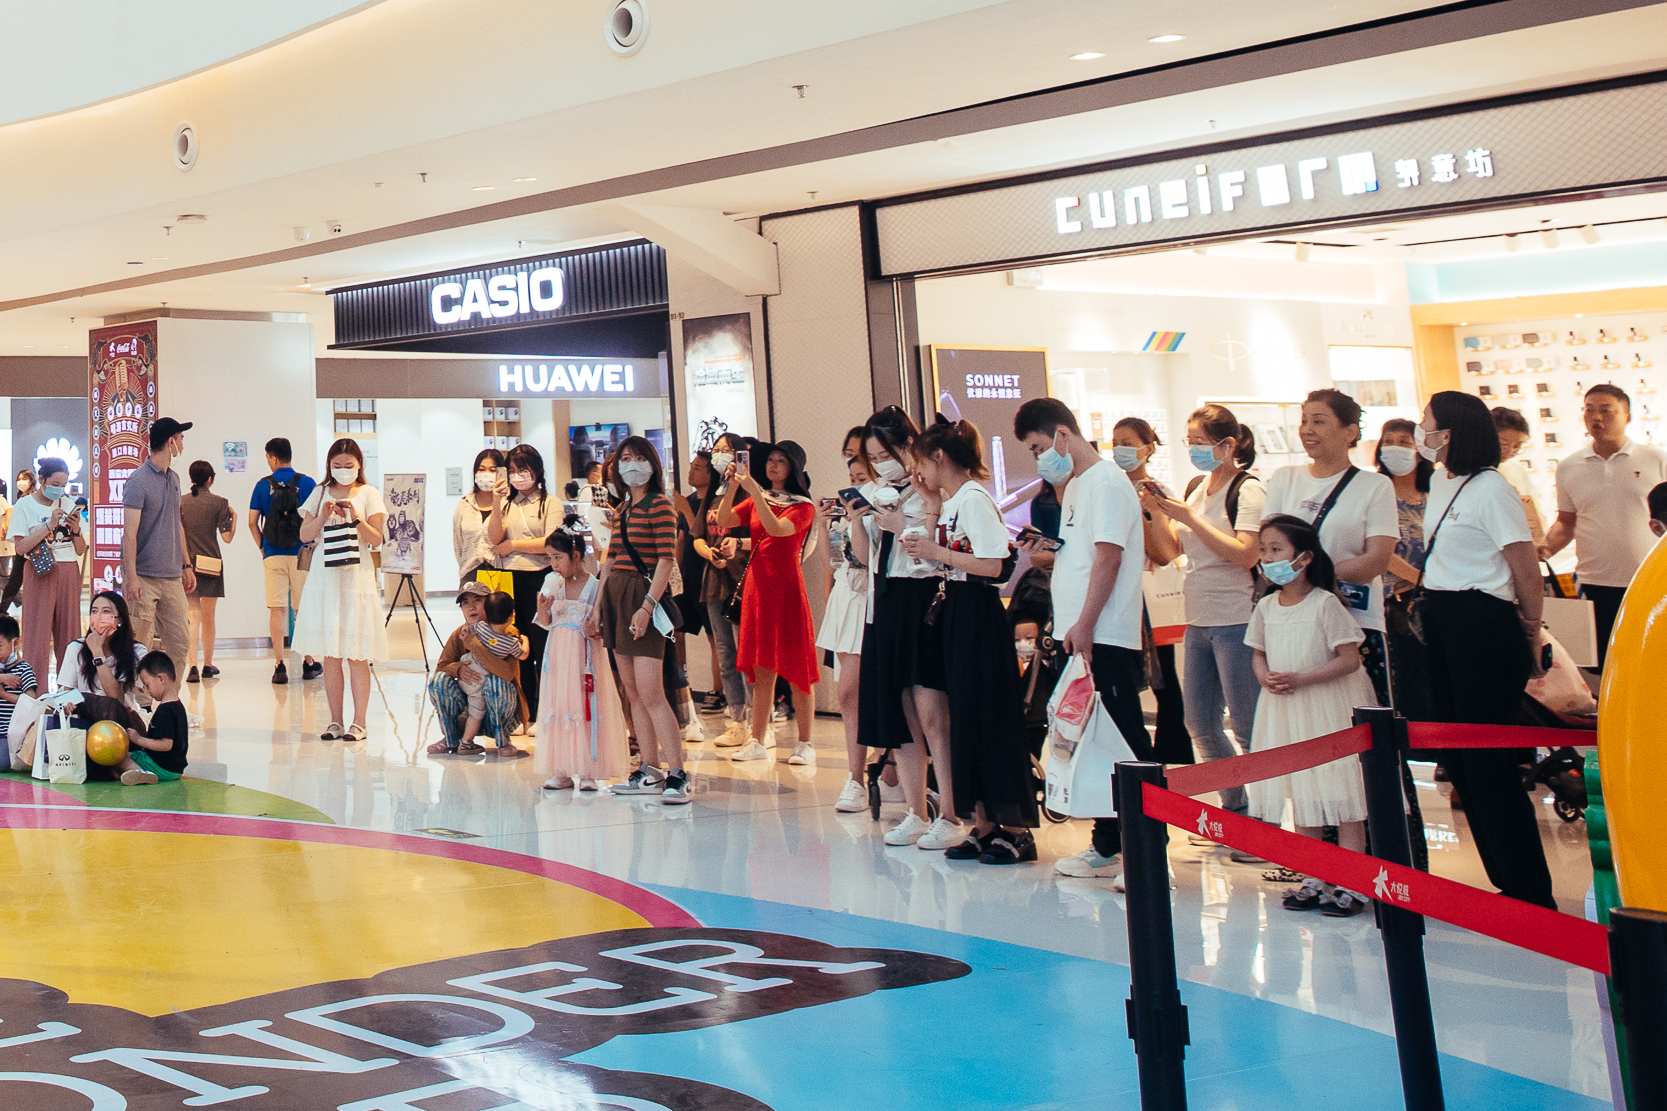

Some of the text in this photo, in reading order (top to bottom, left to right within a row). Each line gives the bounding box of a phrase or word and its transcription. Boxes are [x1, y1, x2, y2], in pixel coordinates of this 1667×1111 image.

[430, 267, 565, 325] CASIO
[498, 364, 634, 392] HUAWEI
[965, 373, 1020, 387] SONNET
